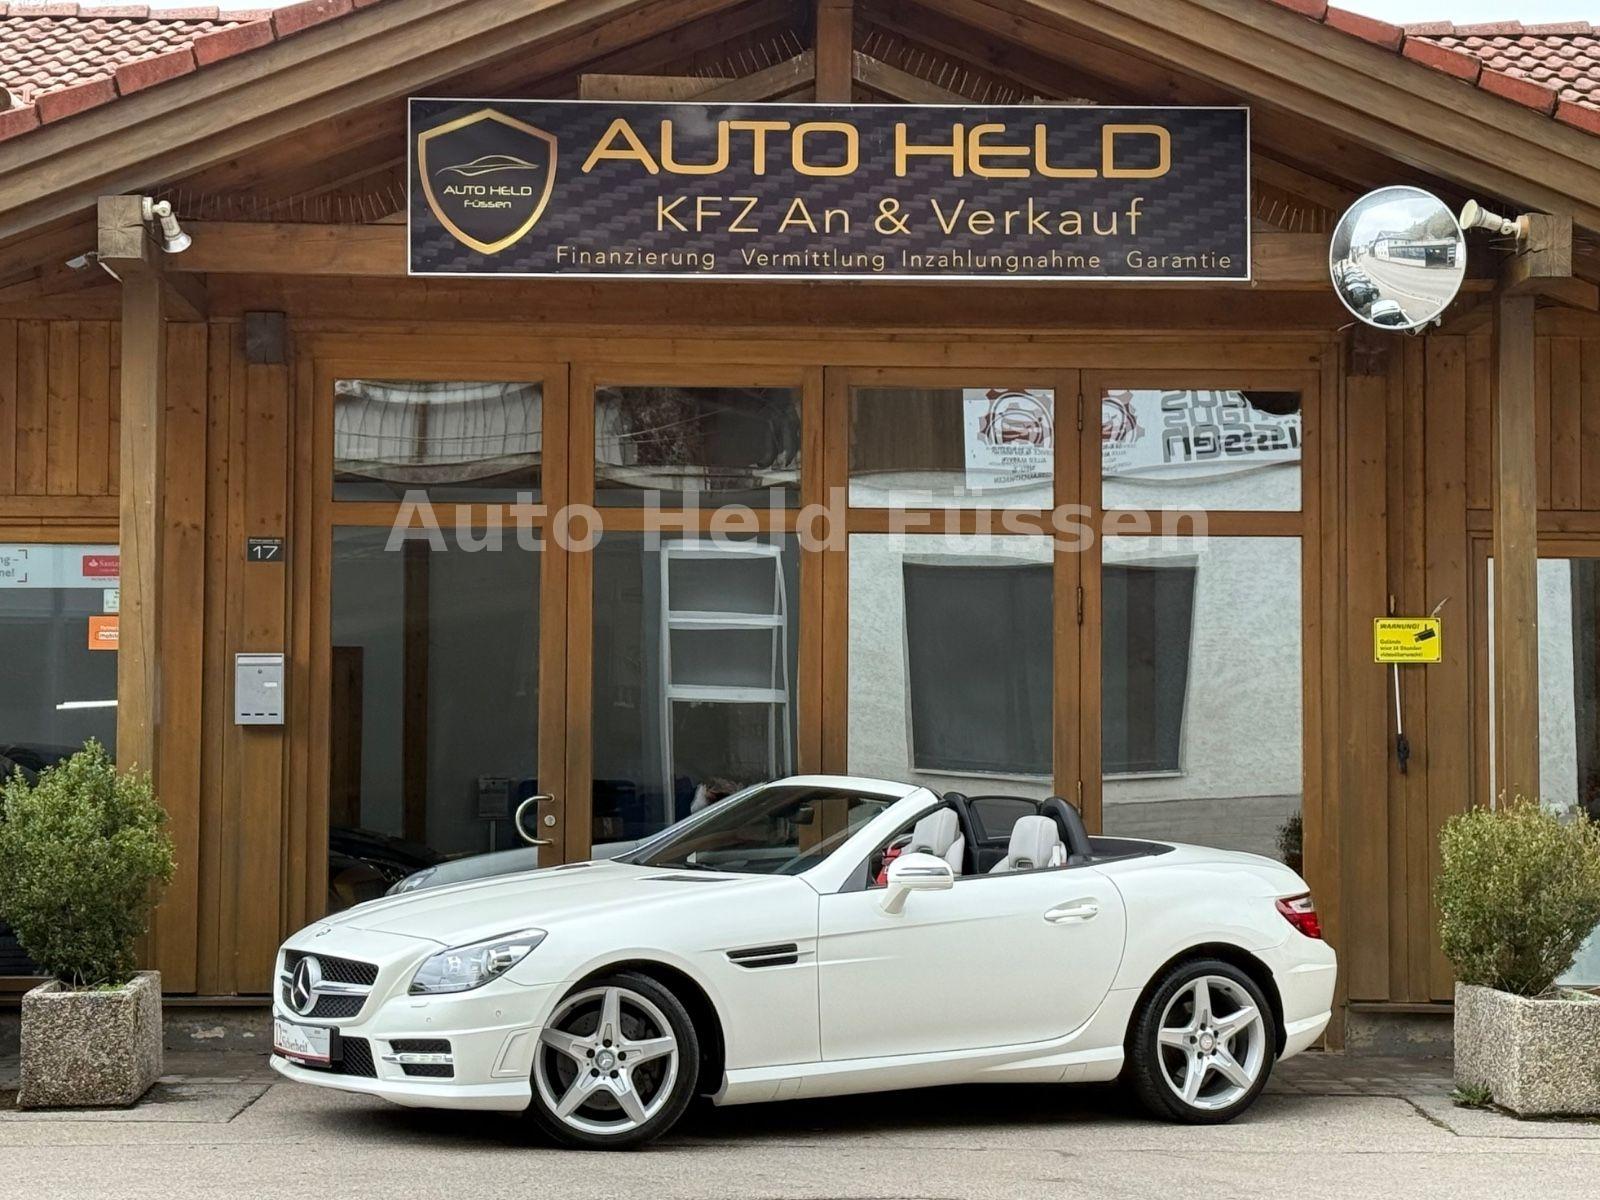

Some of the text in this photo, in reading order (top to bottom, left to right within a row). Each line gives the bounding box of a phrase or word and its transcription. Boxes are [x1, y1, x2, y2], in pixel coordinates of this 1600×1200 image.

[581, 118, 1171, 179] AUTO HELD
[443, 185, 532, 196] AUTO HELD
[464, 199, 512, 208] Füssen
[657, 196, 1144, 235] KFZ An & Verkauf
[556, 245, 1232, 273] Finanzierung Vermittlung Inzahlungnahme Garantie
[252, 545, 279, 559] 17
